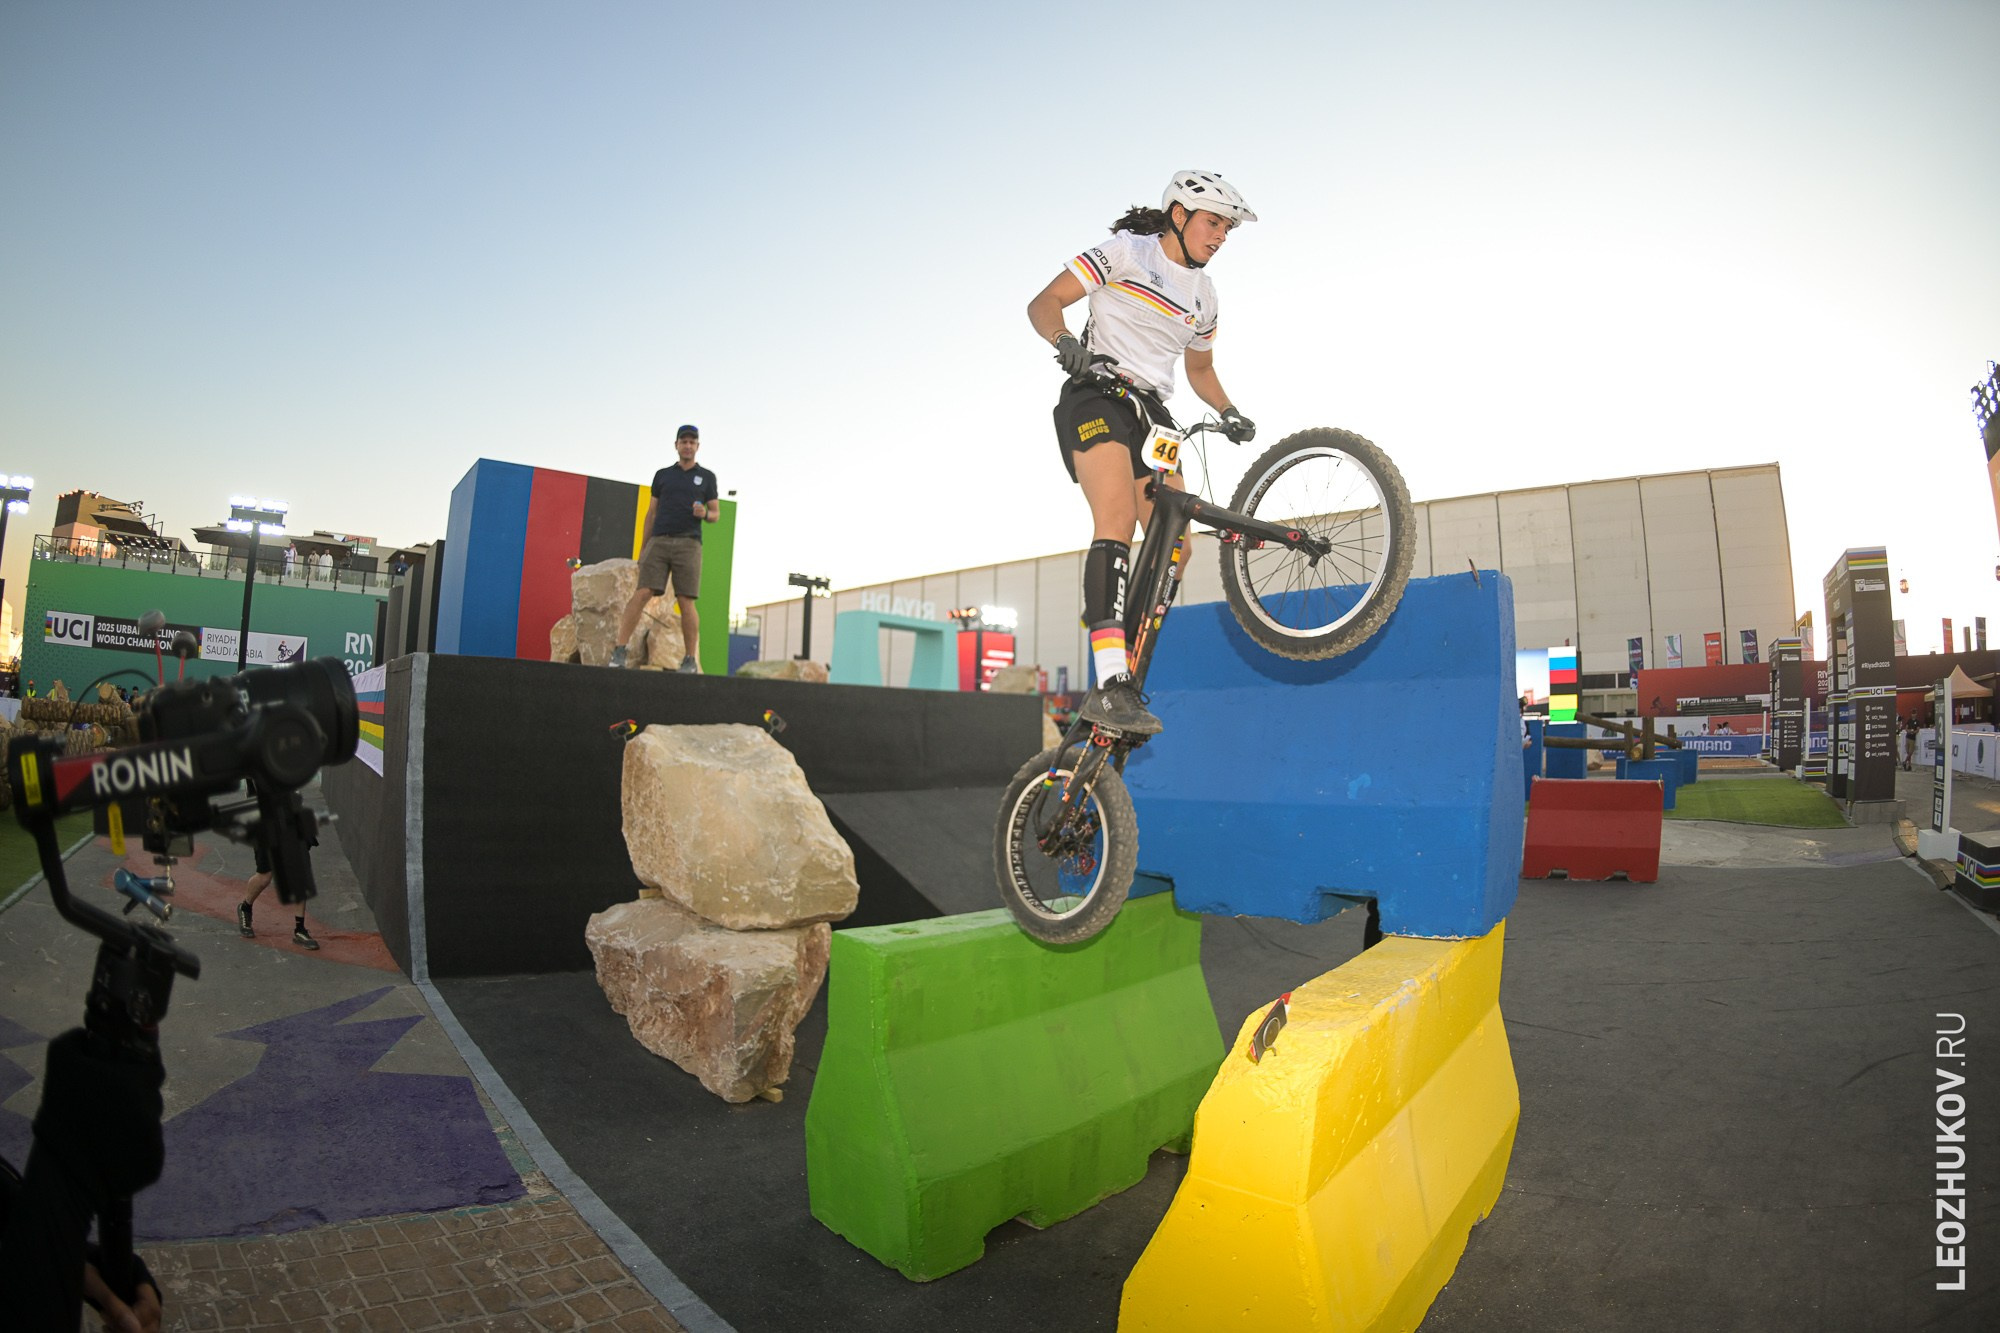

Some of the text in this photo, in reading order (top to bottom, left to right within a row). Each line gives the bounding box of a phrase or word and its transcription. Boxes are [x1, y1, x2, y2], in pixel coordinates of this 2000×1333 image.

[1077, 417, 1106, 434] EMILIA
[1079, 425, 1110, 442] KEIKUS
[1155, 442, 1178, 461] 40
[53, 617, 90, 641] UCI
[96, 622, 115, 633] 2025
[96, 634, 125, 645] WORLD
[206, 633, 237, 645] RIYADH
[205, 645, 263, 659] SAUDI AABIA
[1870, 688, 1884, 696] UCI
[1938, 716, 1944, 745] 3
[91, 746, 194, 796] RONIN
[1963, 855, 1977, 881] UCI
